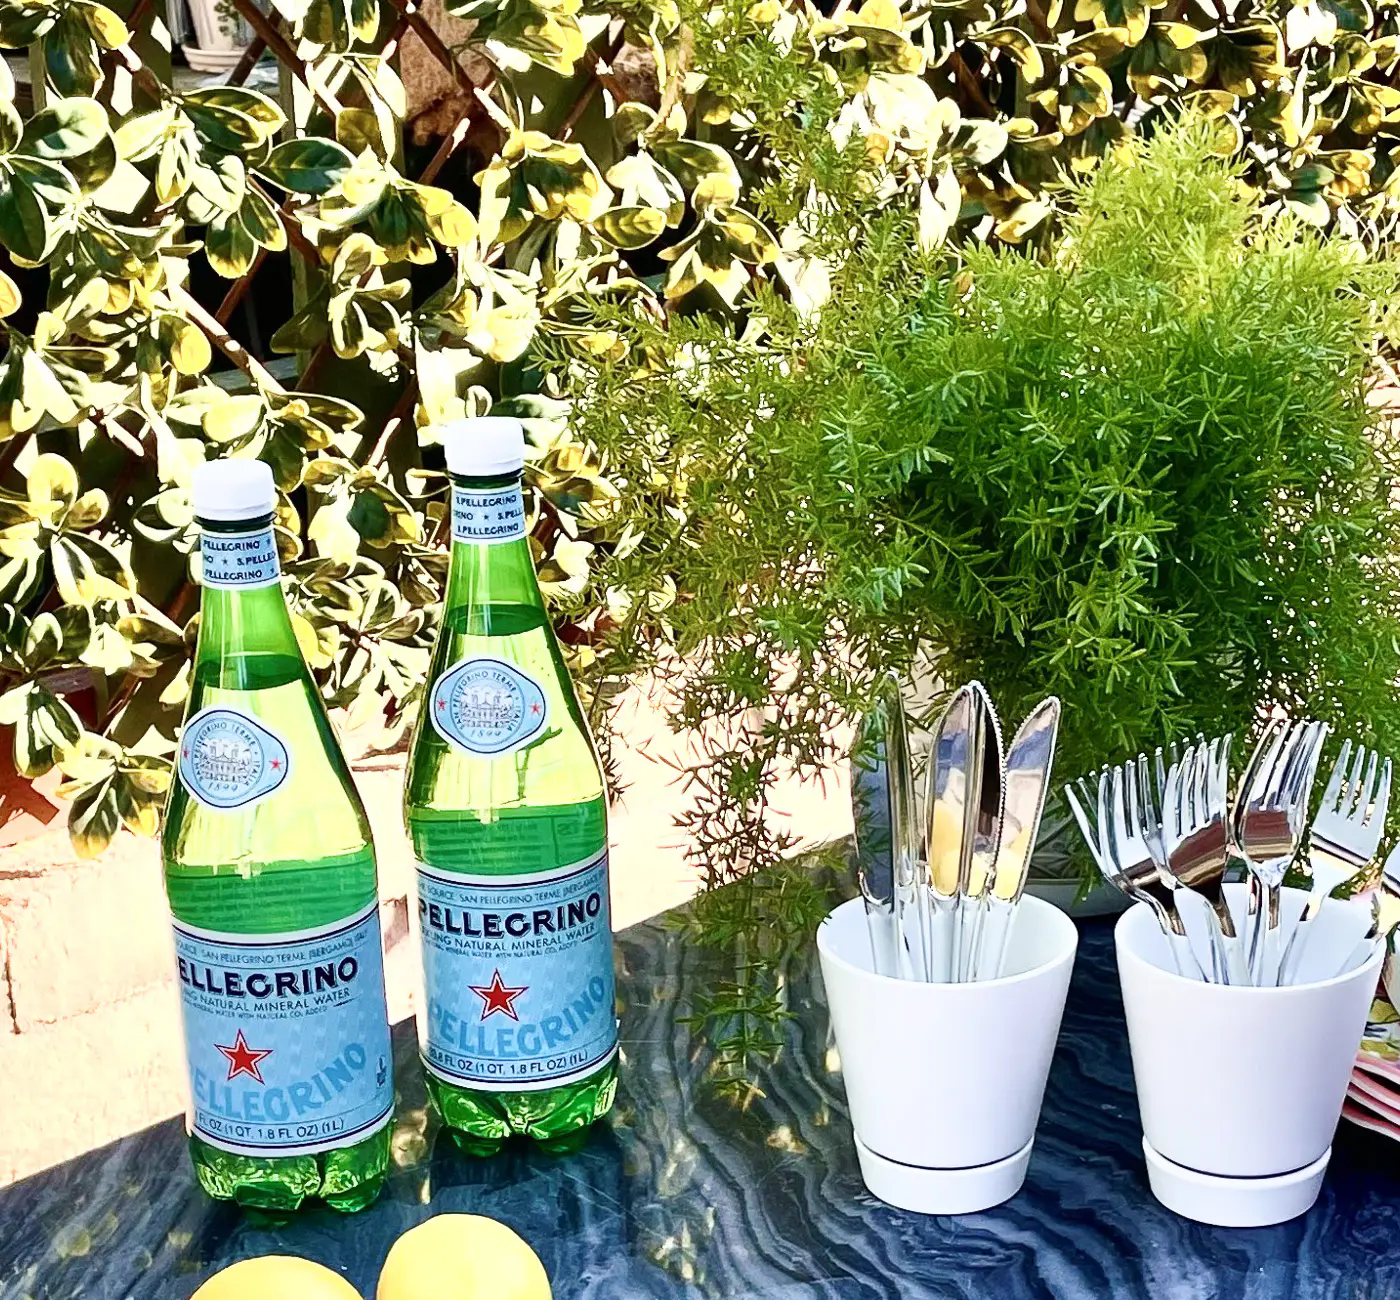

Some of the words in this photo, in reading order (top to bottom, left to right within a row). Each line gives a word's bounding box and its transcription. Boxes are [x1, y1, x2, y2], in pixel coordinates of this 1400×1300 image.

[203, 540, 260, 551] PELLEGRINO
[205, 569, 262, 580] PELLEGRINO
[459, 893, 478, 903] SAN
[480, 894, 533, 905] PELLEGRINO
[534, 888, 561, 900] TERME
[455, 938, 506, 951] NATURAL
[511, 935, 562, 951] MINERAL
[565, 921, 595, 941] WATER
[220, 952, 274, 964] PELLEGRINO
[277, 951, 306, 964] TERME
[200, 994, 249, 1013] NATURAL
[254, 998, 310, 1012] MINERAL
[313, 986, 351, 1005] WATER
[457, 1059, 473, 1071] OZ
[510, 1064, 527, 1075] 1.8
[530, 1062, 544, 1073] FL
[546, 1057, 567, 1070] OZ)
[209, 1118, 222, 1132] OZ
[278, 1128, 293, 1139] FL
[296, 1123, 319, 1138] OZ)
